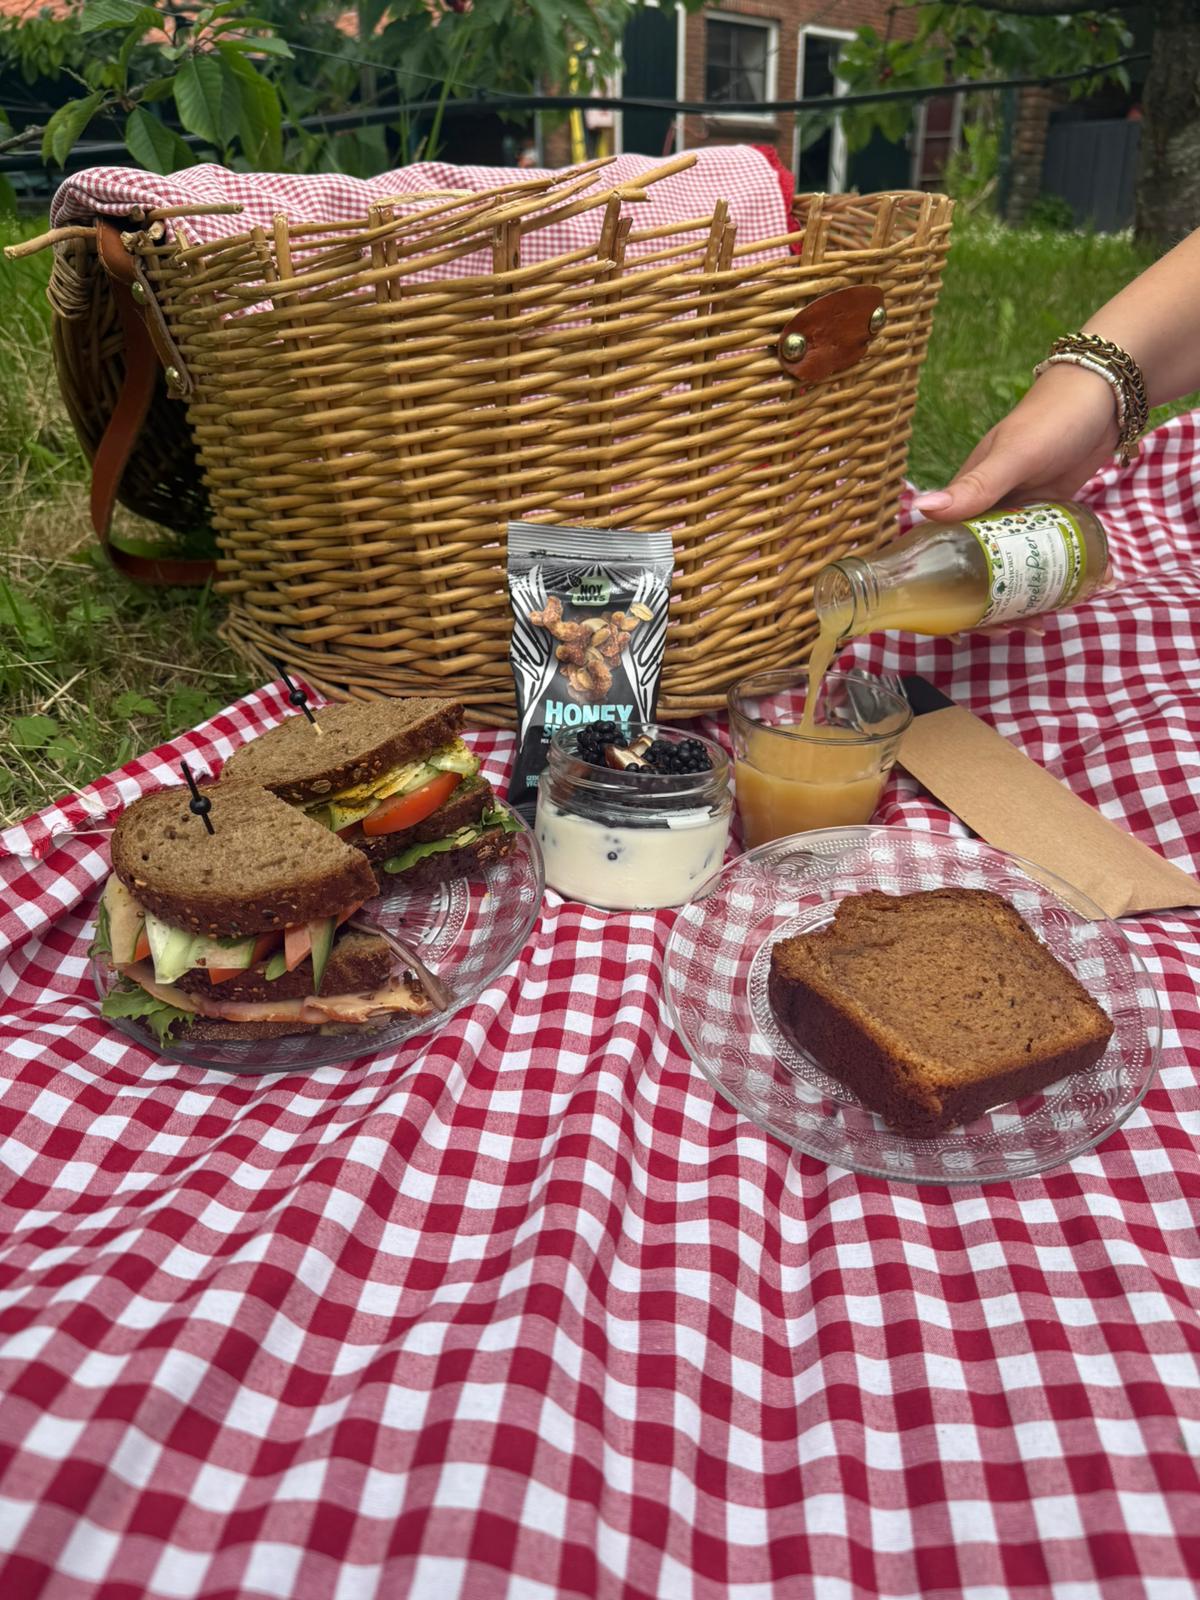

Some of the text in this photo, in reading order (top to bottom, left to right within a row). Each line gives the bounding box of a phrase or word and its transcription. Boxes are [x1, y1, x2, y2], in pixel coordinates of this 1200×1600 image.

[580, 584, 603, 596] NOY
[1016, 536, 1045, 615] Appel & Peer
[544, 699, 634, 730] HONEY
